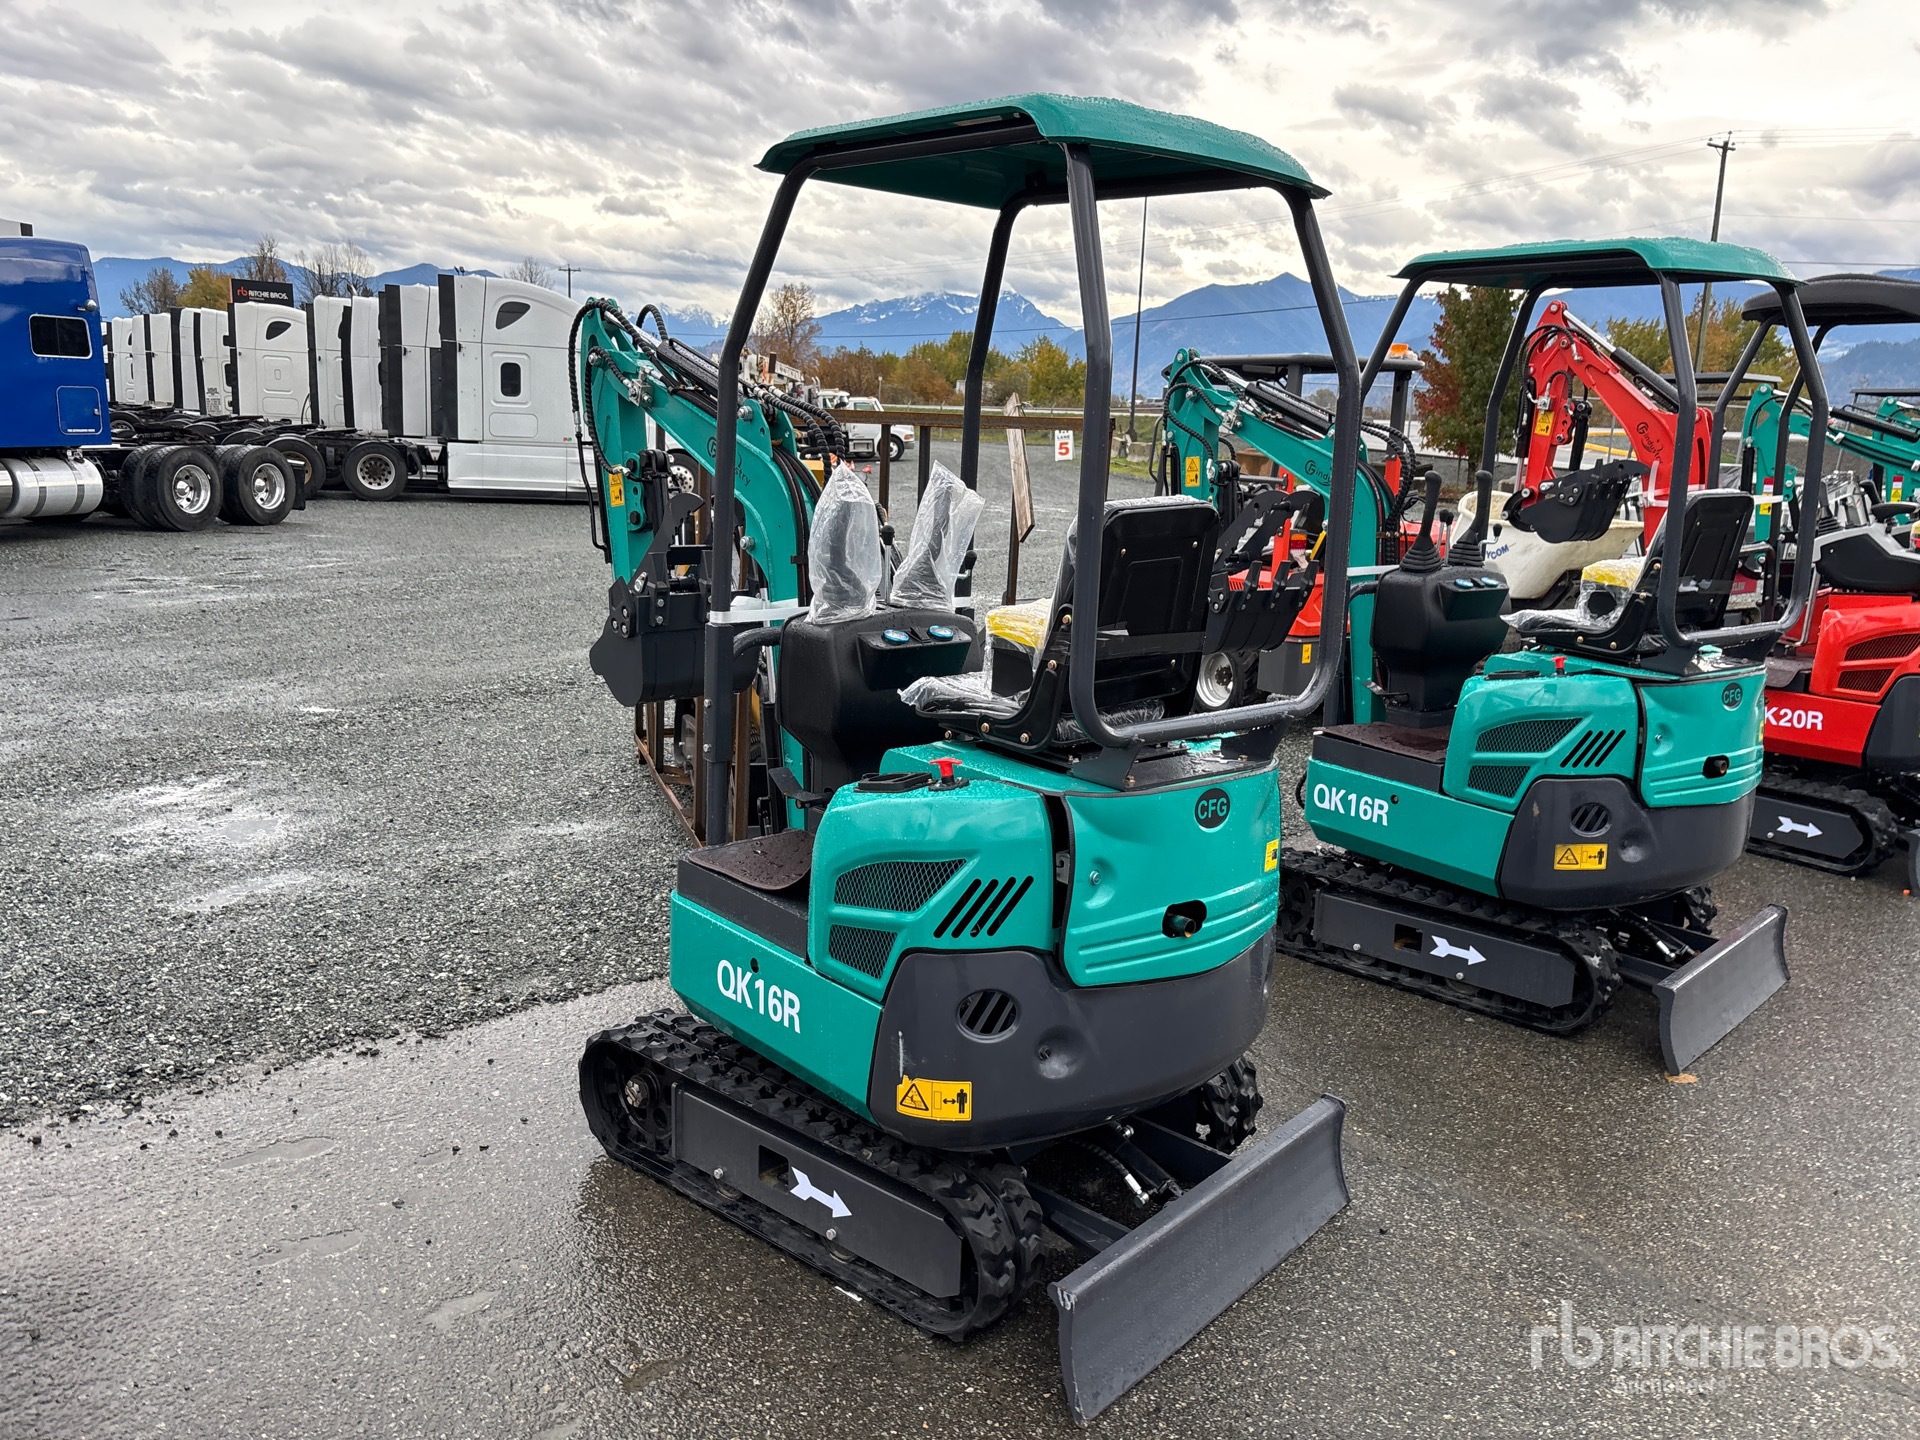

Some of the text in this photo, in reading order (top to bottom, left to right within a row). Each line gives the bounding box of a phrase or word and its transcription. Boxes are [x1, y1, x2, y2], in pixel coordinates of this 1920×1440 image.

[248, 289, 270, 298] RITCHIE
[1058, 441, 1070, 456] 5
[1723, 688, 1741, 704] CFG
[1764, 706, 1824, 731] K20R
[1197, 797, 1228, 820] CFG
[1313, 783, 1389, 826] QK16R
[717, 959, 801, 1034] QK16R
